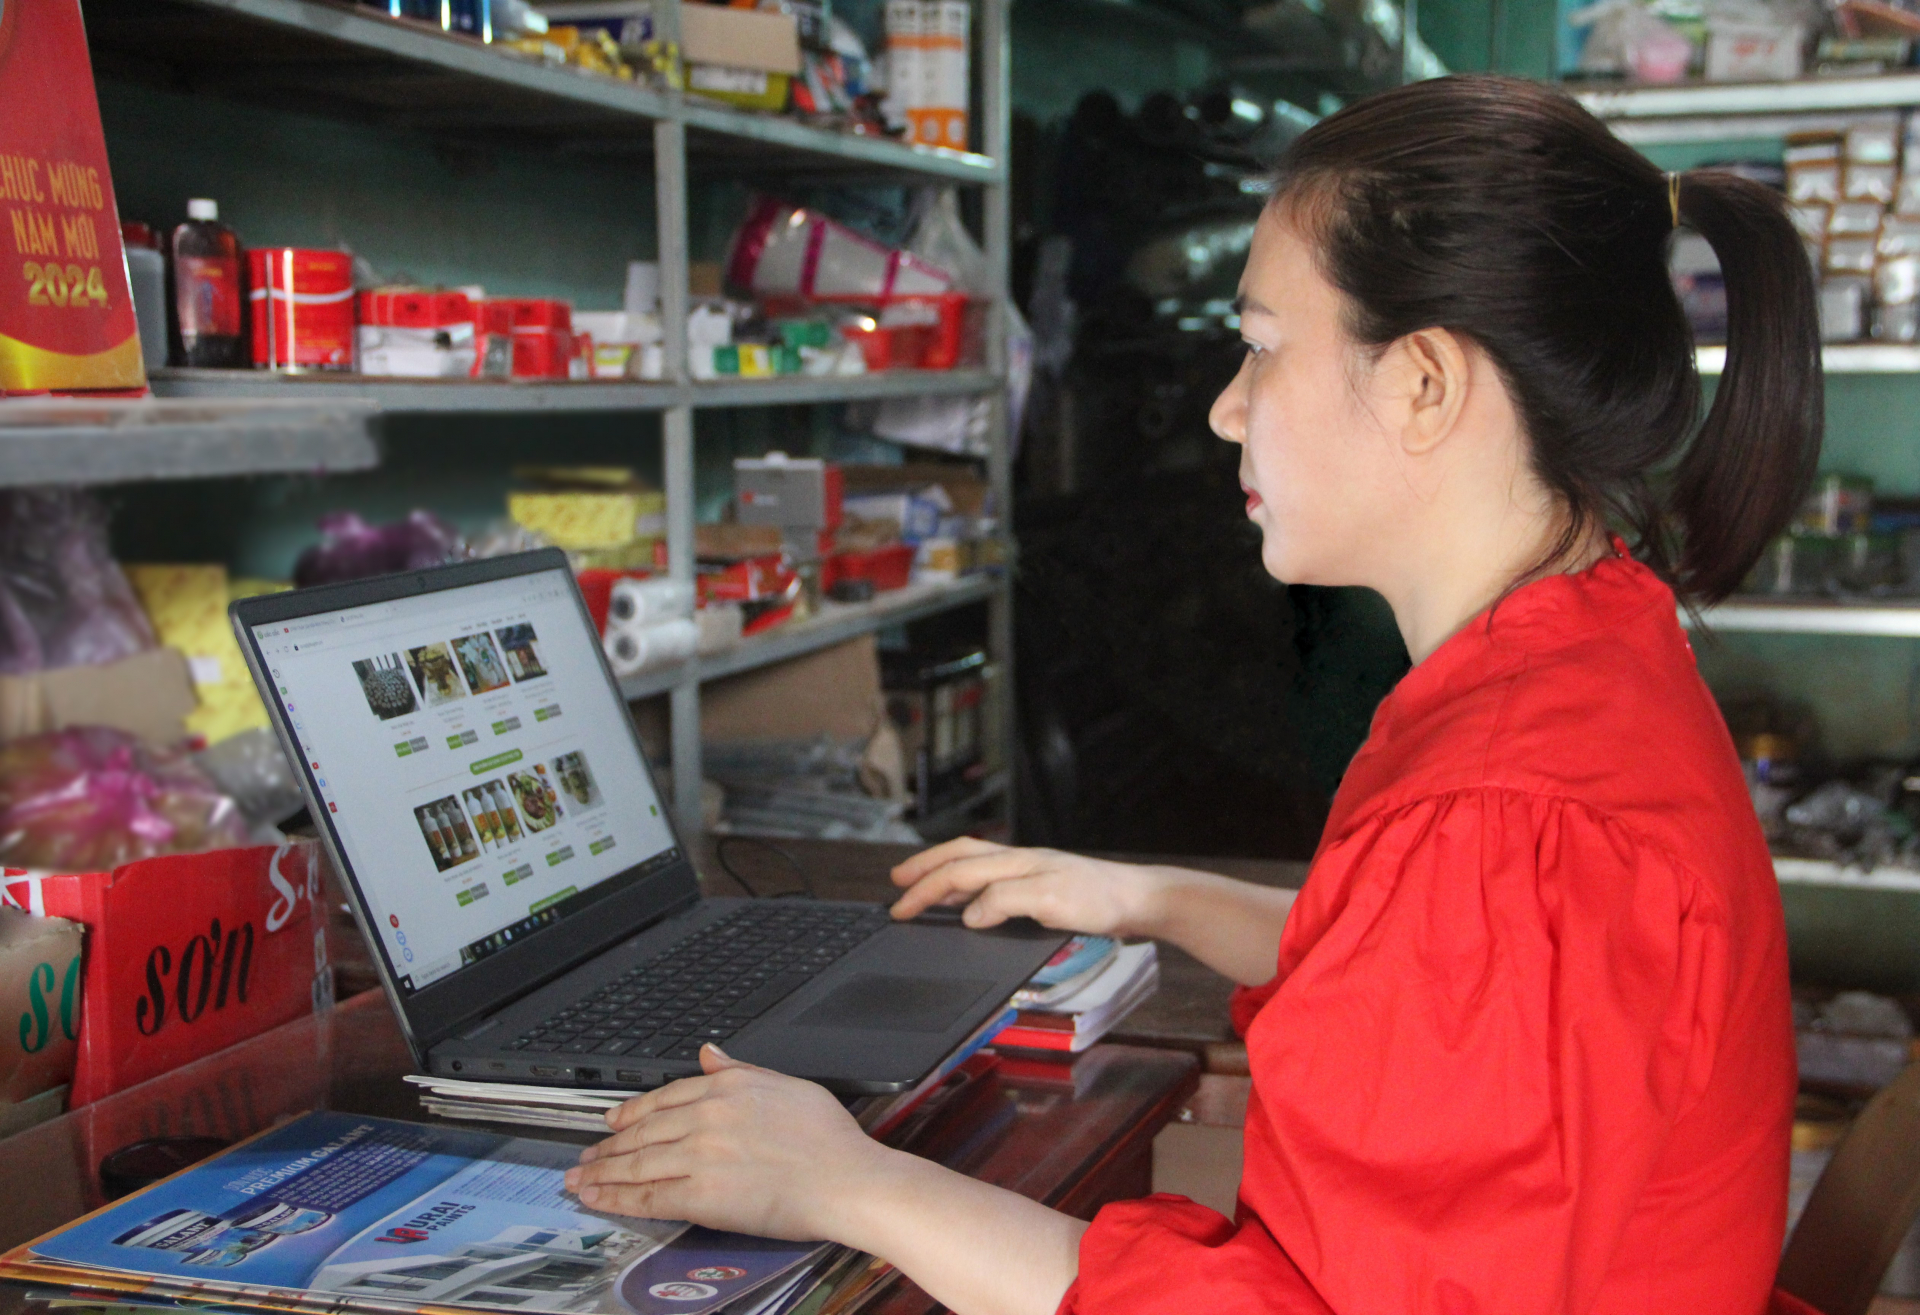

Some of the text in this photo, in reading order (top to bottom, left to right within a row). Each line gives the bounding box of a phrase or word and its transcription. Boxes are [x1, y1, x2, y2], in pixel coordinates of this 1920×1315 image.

[23, 261, 108, 308] 2024
[240, 1157, 315, 1195] PREMIUM
[311, 1124, 375, 1158] GALANT
[155, 1220, 210, 1249] GALANT
[426, 1204, 476, 1231] PAINTS
